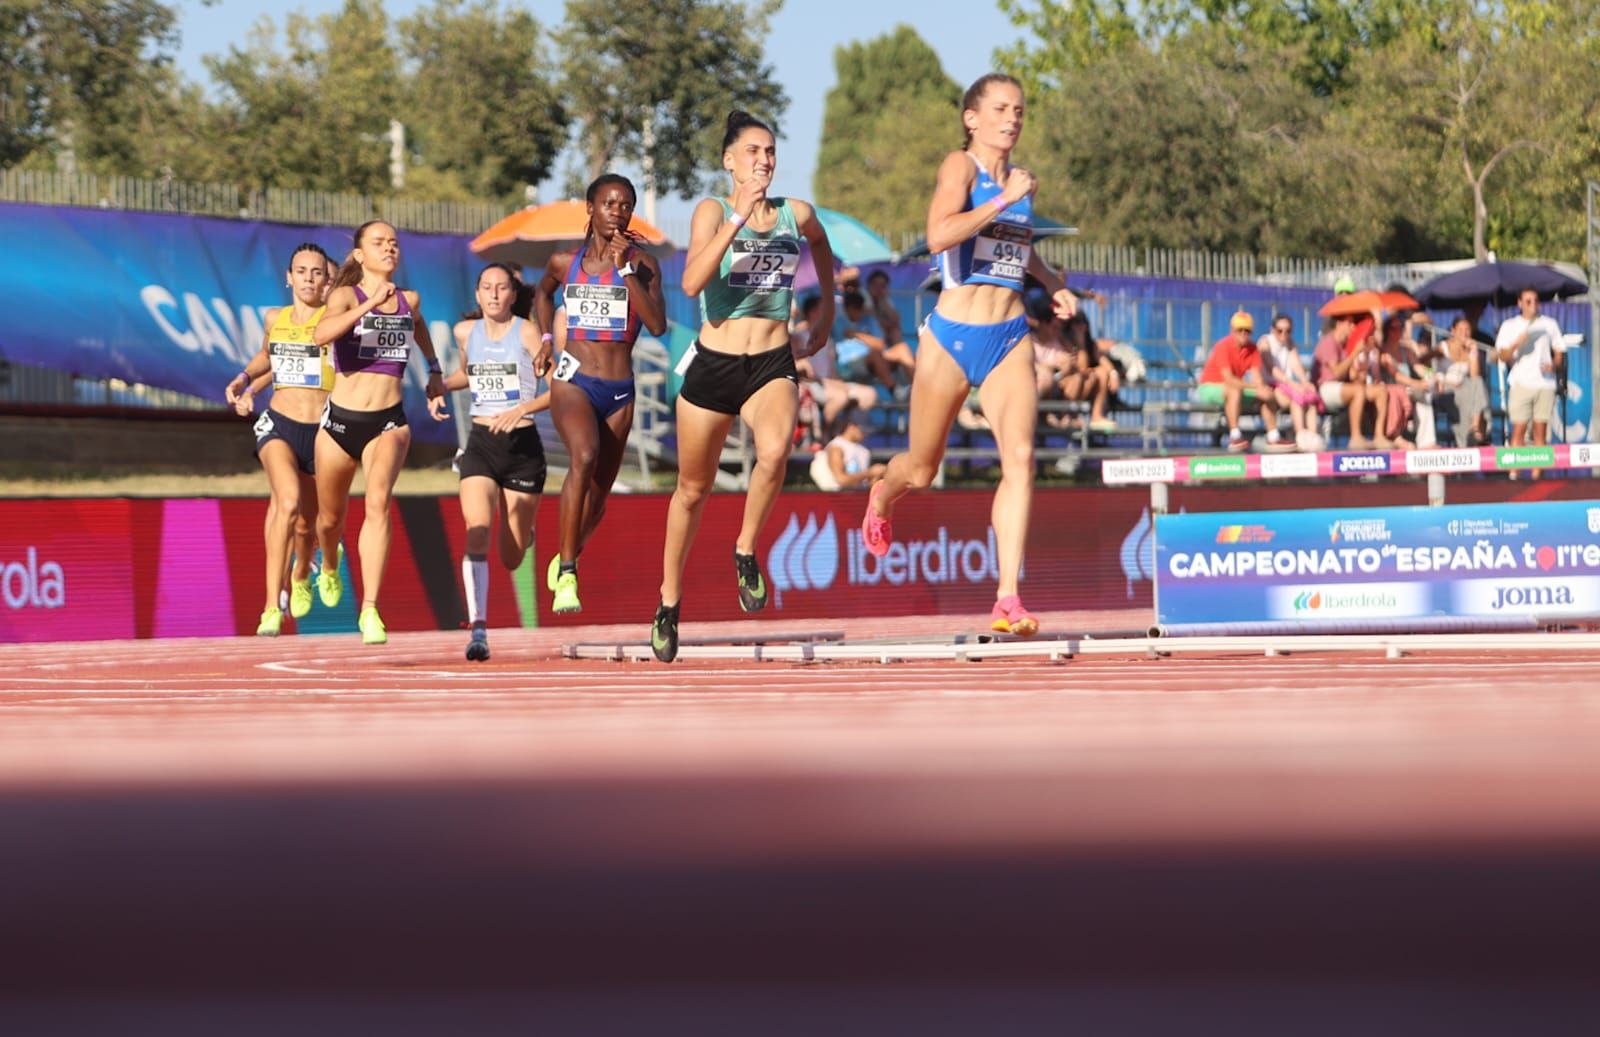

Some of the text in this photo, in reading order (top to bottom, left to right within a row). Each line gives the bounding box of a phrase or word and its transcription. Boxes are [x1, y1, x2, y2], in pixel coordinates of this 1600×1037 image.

[993, 243, 1023, 262] 494
[751, 255, 784, 271] 752
[580, 301, 610, 315] 628
[377, 332, 406, 346] 609
[277, 358, 305, 372] 738
[477, 377, 504, 391] 598
[1413, 453, 1473, 467] TORRENT 2023
[1109, 464, 1167, 478] TORRENT 2023
[847, 526, 1025, 585] Iberdrol
[1169, 548, 1382, 578] CAMPEONATO
[1397, 539, 1517, 571] ESPAÑA
[0, 546, 65, 609] ola
[1324, 593, 1397, 610] Iberdrola
[1491, 585, 1575, 609] Joma
